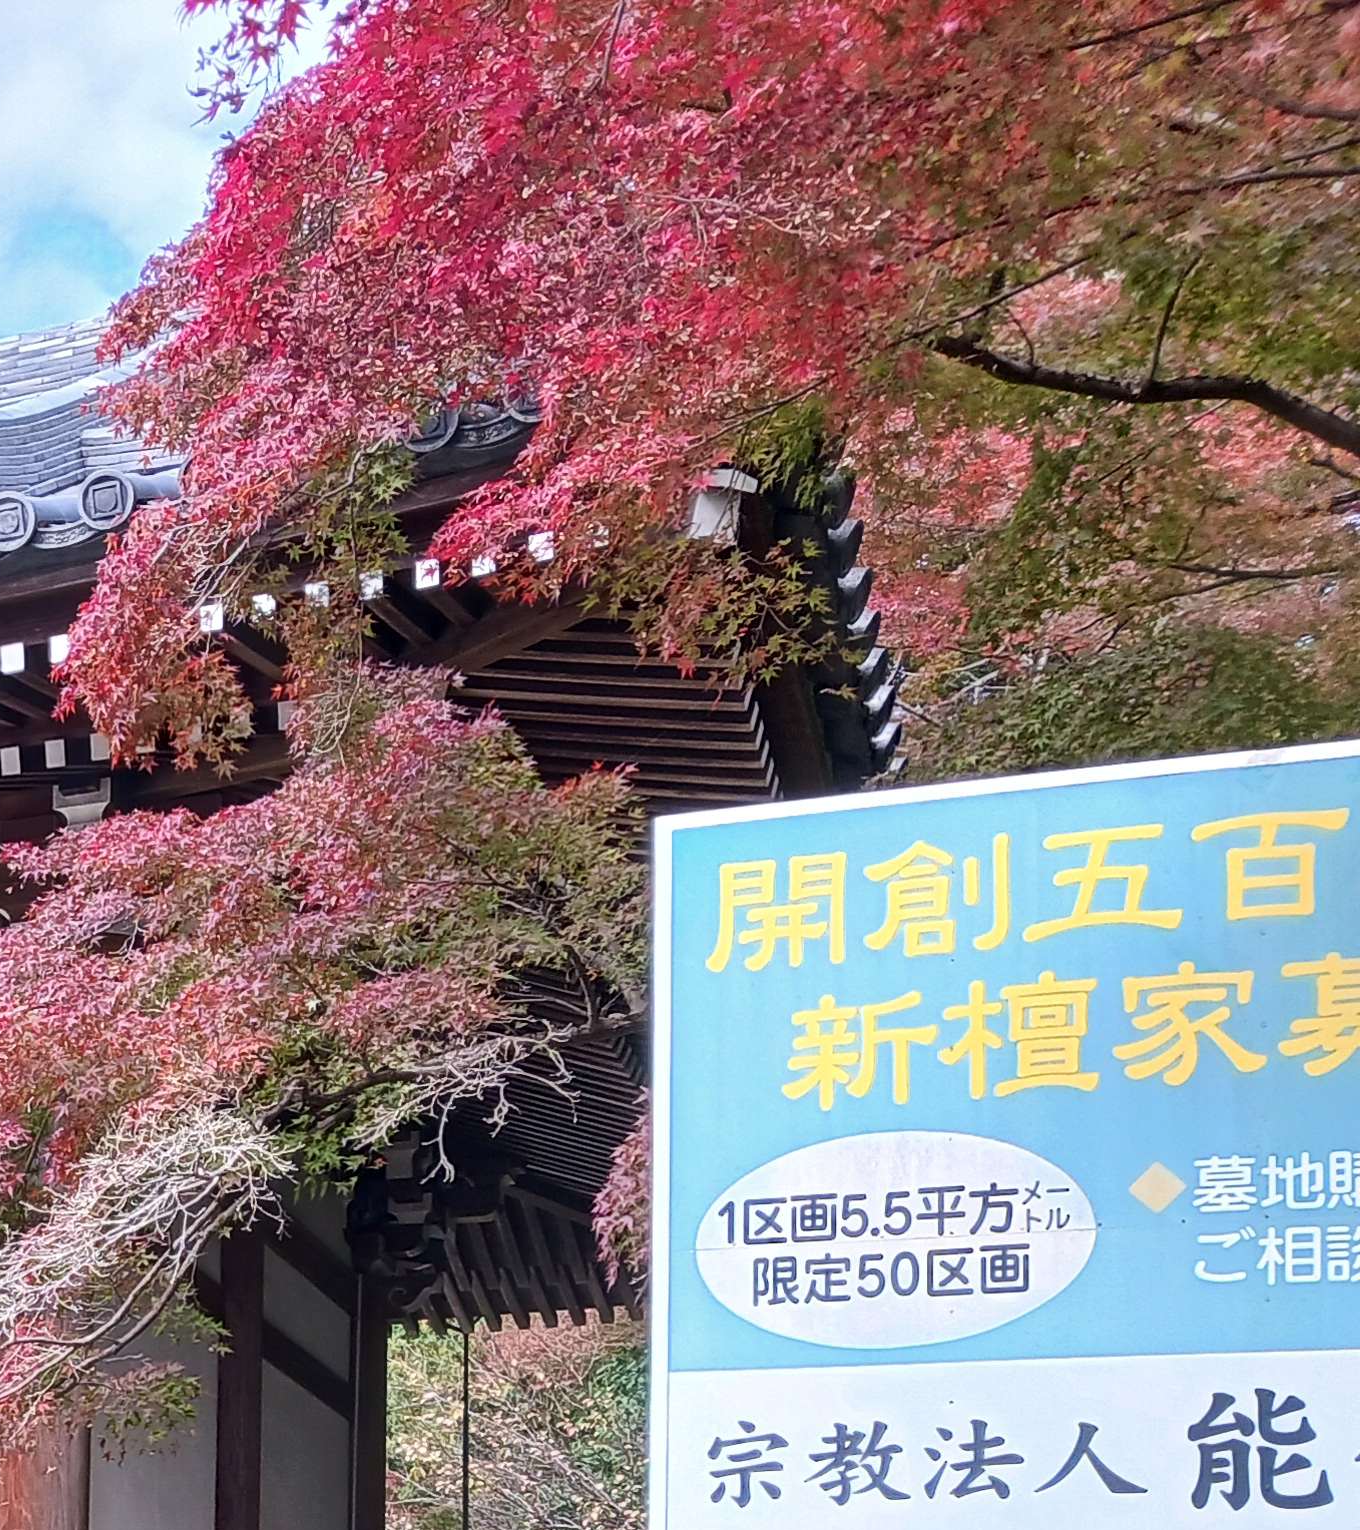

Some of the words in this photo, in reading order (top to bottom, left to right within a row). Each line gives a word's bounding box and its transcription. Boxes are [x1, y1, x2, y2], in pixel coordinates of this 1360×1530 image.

[705, 806, 1350, 973] 開創五百
[752, 1243, 1031, 1307] 限定50区画
[1186, 1388, 1360, 1510] 能
